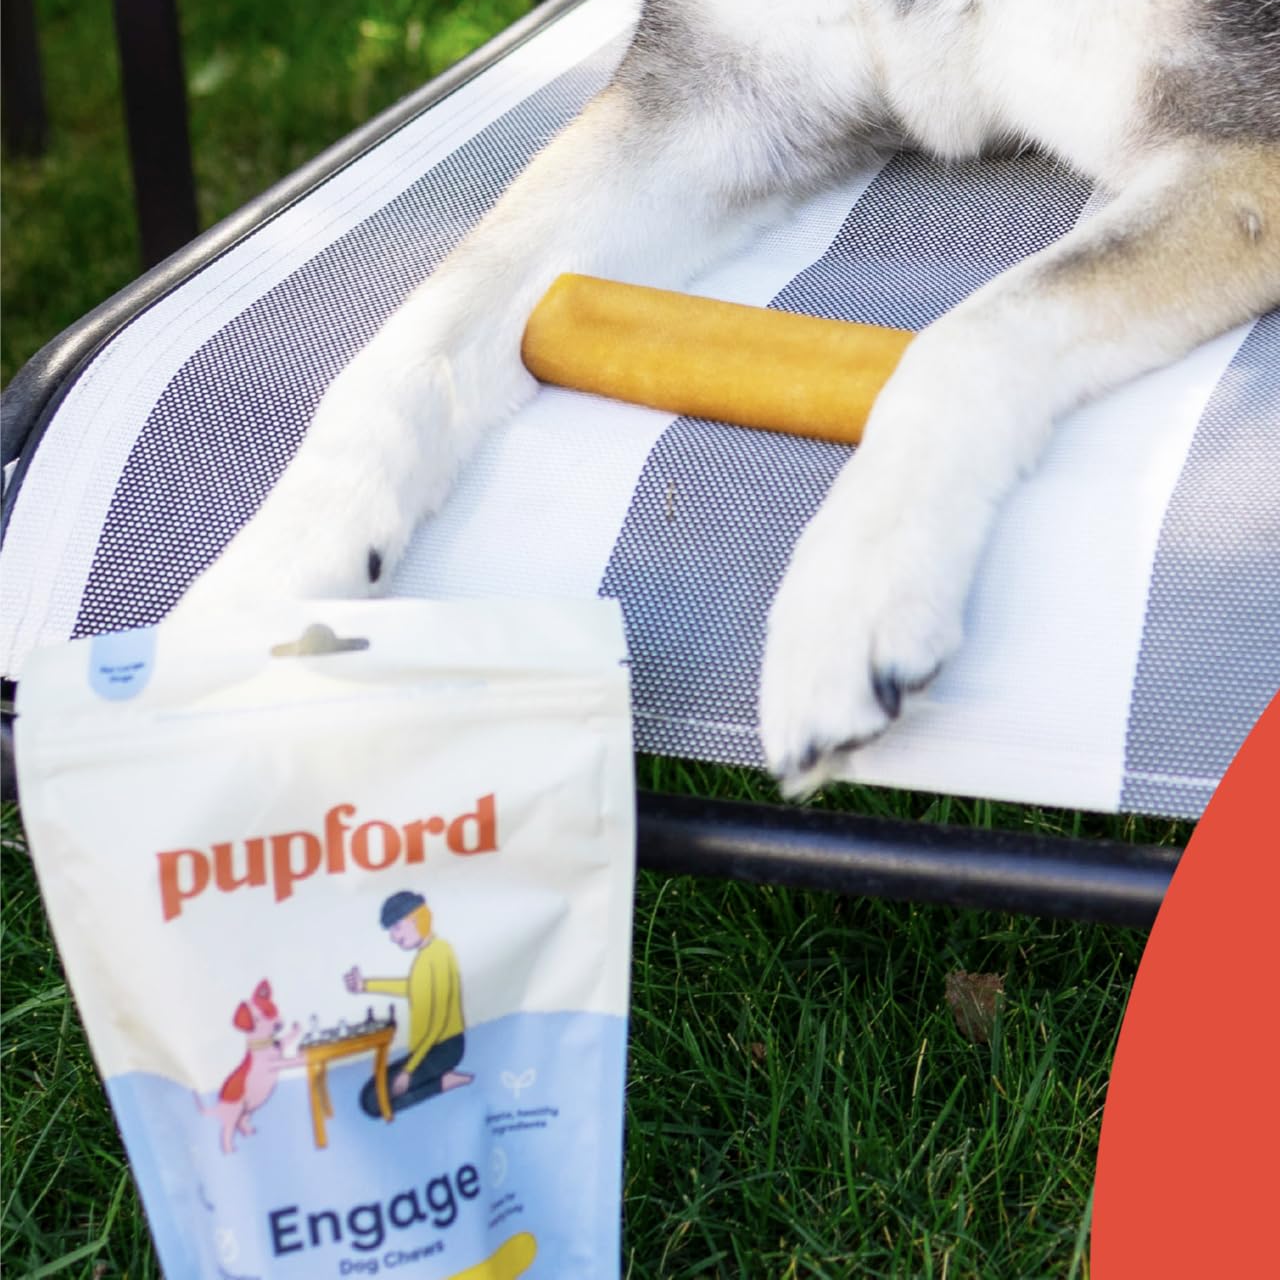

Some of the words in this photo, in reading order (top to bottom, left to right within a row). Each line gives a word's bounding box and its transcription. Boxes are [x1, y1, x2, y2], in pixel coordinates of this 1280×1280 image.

[156, 792, 500, 924] pupford
[268, 1163, 481, 1258] Engage
[338, 1258, 380, 1276] Dog
[382, 1239, 446, 1269] Chews
